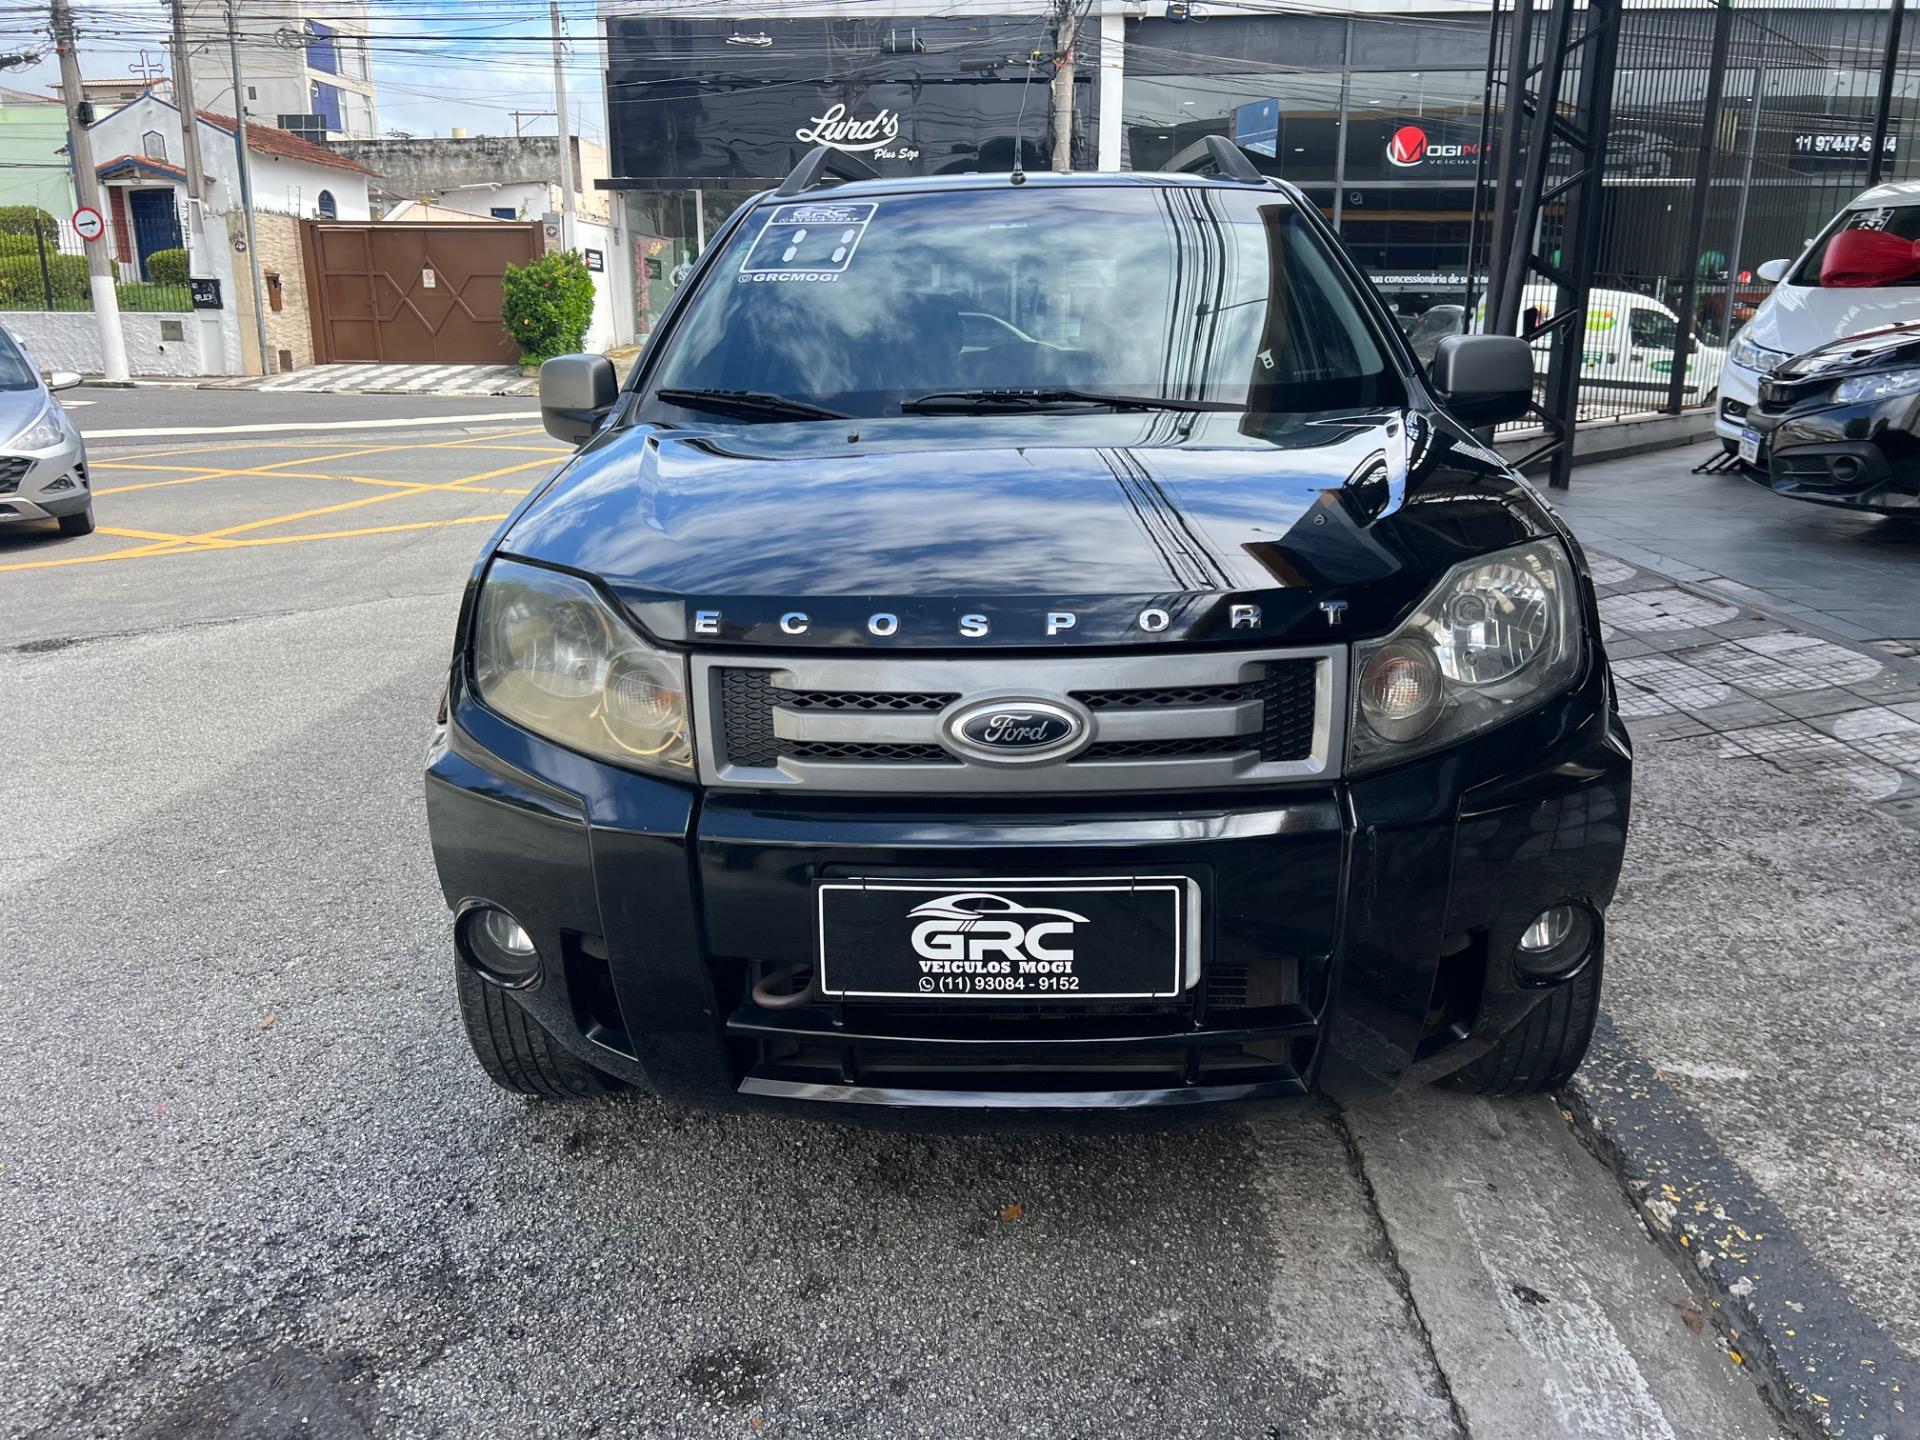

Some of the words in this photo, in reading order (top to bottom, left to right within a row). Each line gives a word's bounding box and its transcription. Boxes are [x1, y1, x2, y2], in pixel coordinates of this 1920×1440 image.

[796, 103, 899, 147] Lurd's
[1796, 135, 1812, 151] 11
[1815, 135, 1897, 152] 97447-64
[874, 148, 896, 160] Plus
[898, 148, 920, 161] Size
[1384, 273, 1447, 284] concessionária
[1448, 273, 1459, 284] de
[984, 714, 1049, 742] Ford
[911, 920, 1074, 961] GRC
[919, 961, 1011, 973] VEICULOS
[1019, 961, 1072, 973] MOGI
[939, 976, 971, 993] (11)
[975, 976, 1025, 990] 93084
[1038, 976, 1079, 990] 9152
